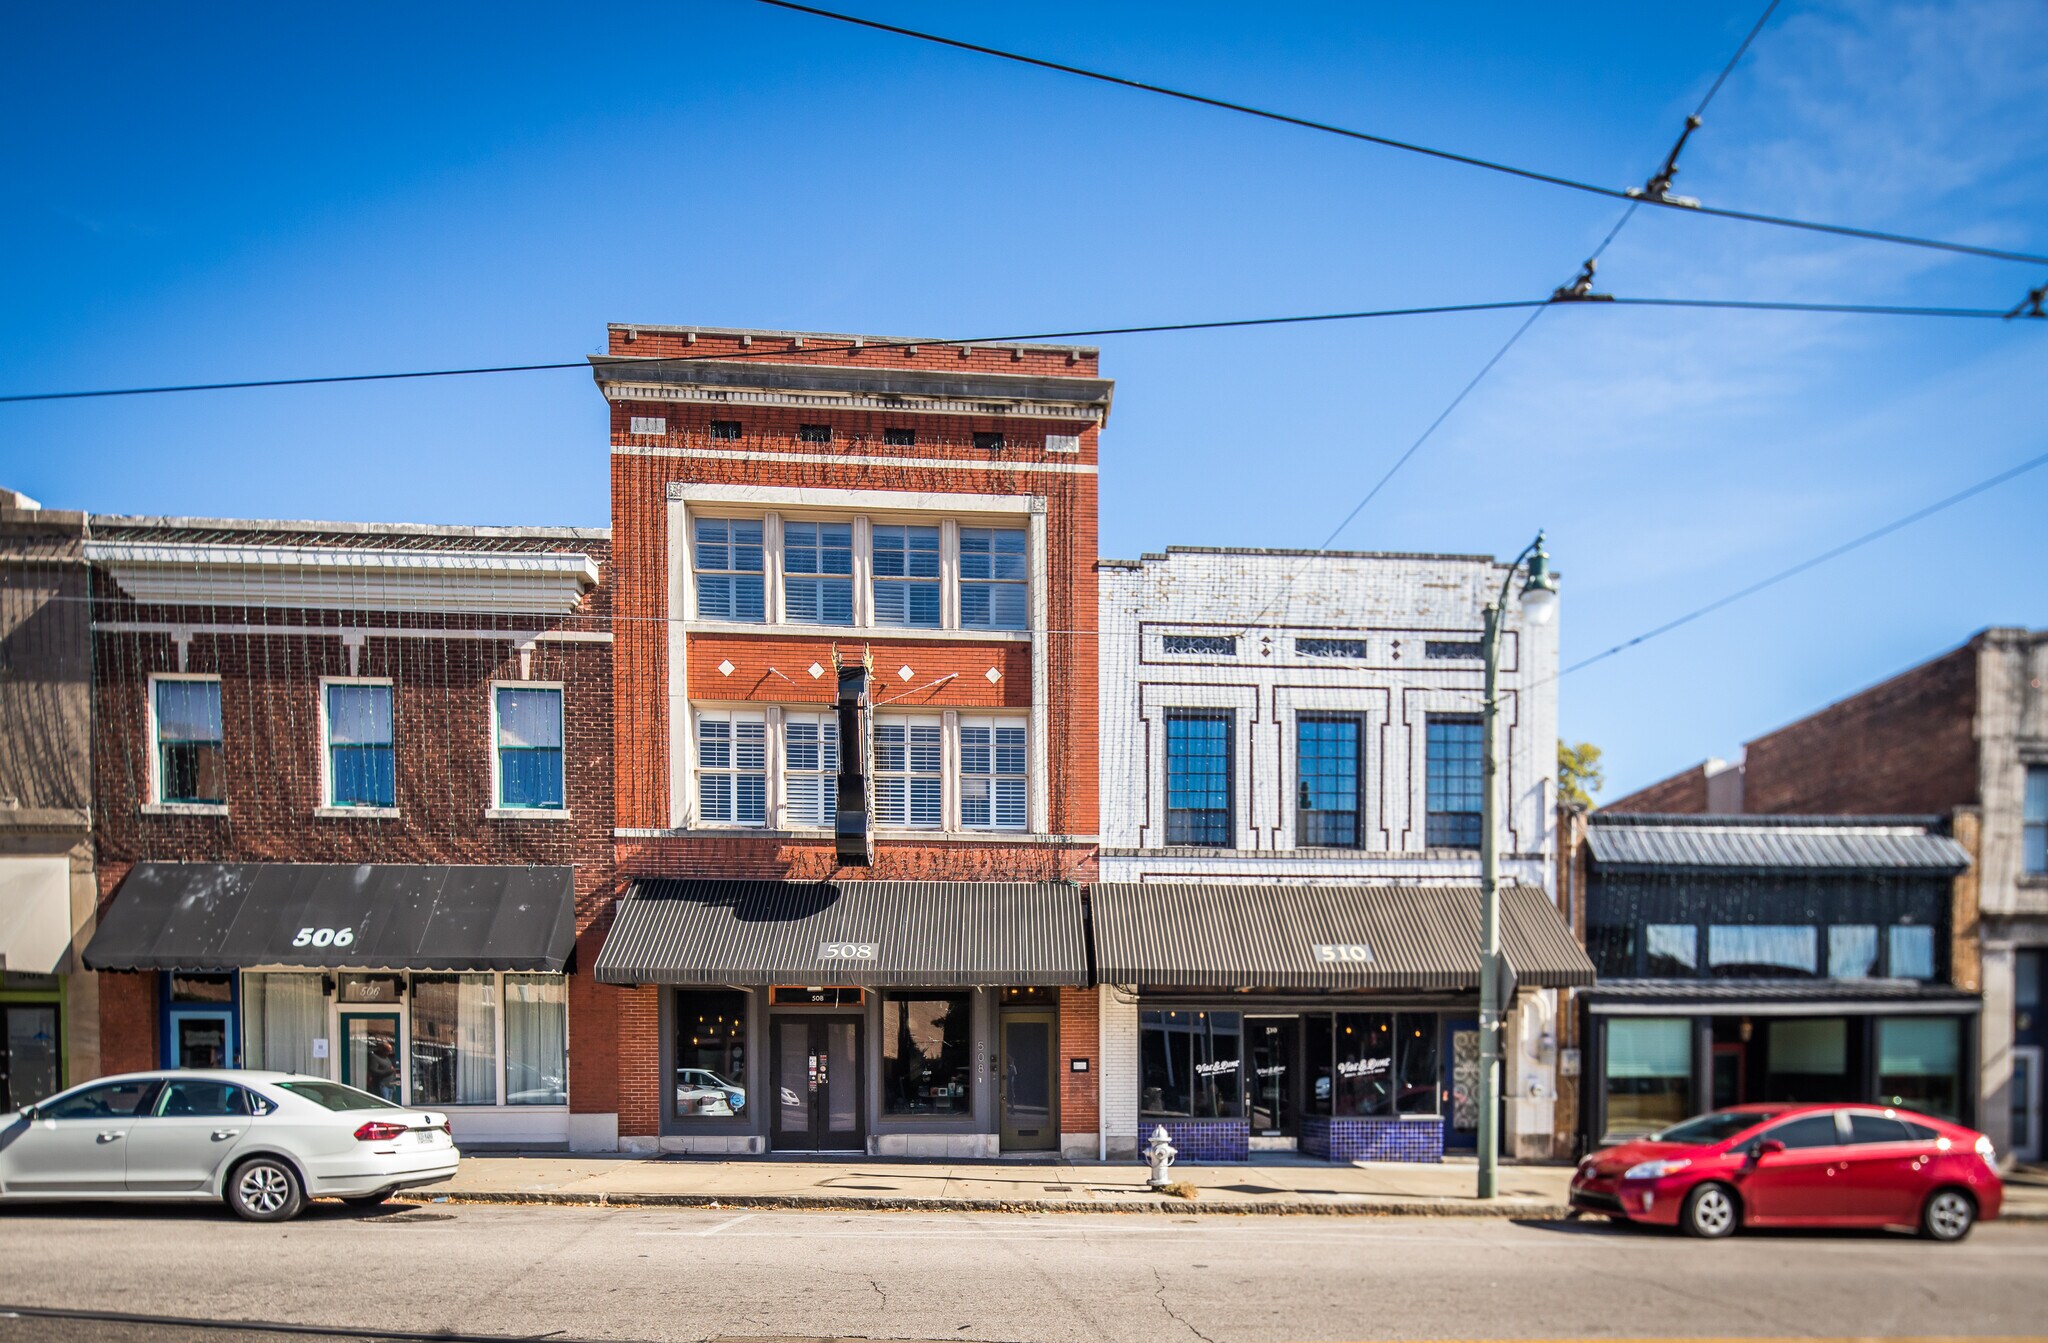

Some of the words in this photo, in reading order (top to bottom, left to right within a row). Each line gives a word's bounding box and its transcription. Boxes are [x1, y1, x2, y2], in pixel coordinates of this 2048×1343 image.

[292, 927, 354, 947] 506
[824, 944, 871, 958] 508
[1321, 945, 1367, 961] 510
[360, 986, 380, 996] 506
